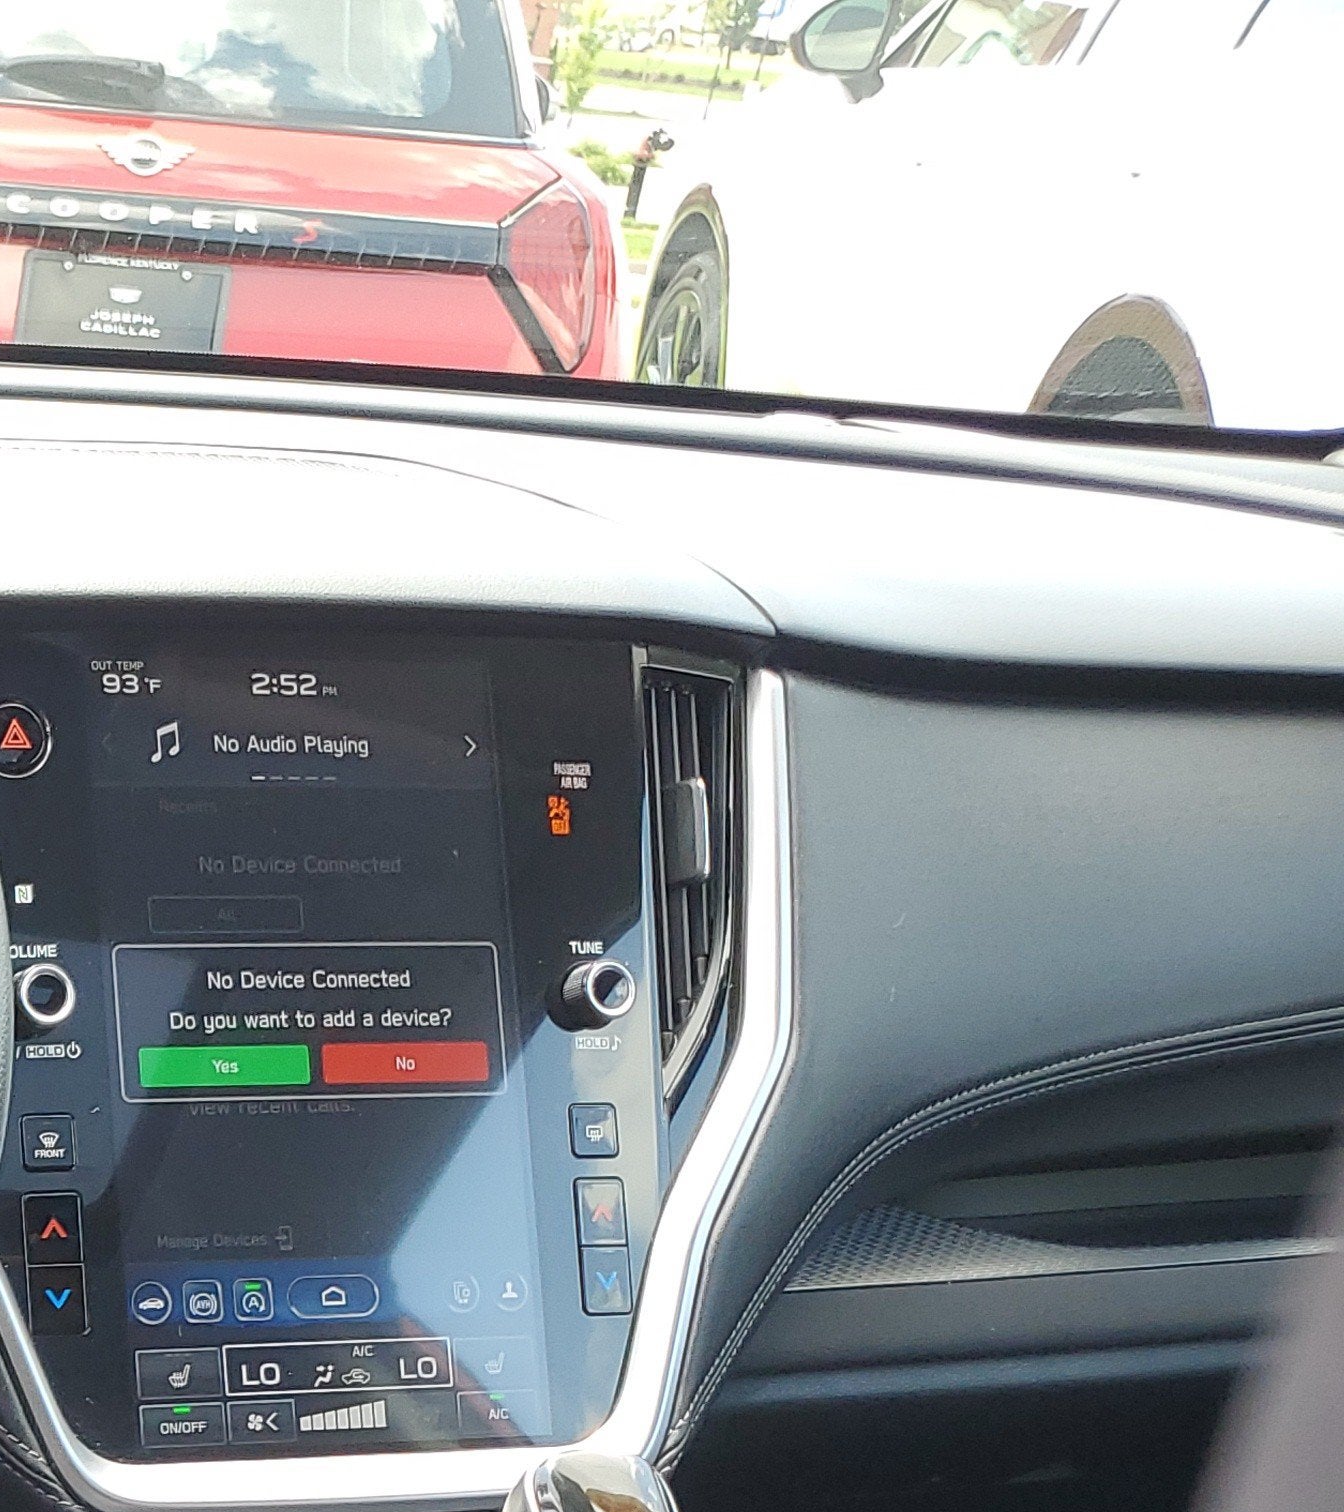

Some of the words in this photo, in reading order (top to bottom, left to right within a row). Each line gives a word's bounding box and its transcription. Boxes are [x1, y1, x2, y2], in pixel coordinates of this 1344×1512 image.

[6, 194, 259, 234] COOPER
[89, 308, 155, 326] JOSEPH
[80, 319, 161, 339] CADILLAC
[91, 660, 112, 671] OUT
[116, 660, 144, 671] TEMP
[102, 673, 139, 694] 93
[250, 673, 317, 696] 2:52
[213, 735, 239, 752] No
[247, 735, 296, 753] Audio
[304, 735, 369, 758] Playing
[199, 855, 224, 873] No
[232, 854, 296, 873] Device
[303, 854, 402, 873] Connected
[10, 944, 58, 958] OLUME
[569, 941, 604, 954] TUNE
[207, 971, 233, 989] No
[241, 971, 305, 989] Device
[312, 969, 411, 988] Connected
[170, 1012, 196, 1030] Do
[203, 1013, 237, 1034] you
[244, 1012, 289, 1029] want
[295, 1012, 315, 1029] to
[323, 1009, 355, 1028] add
[363, 1013, 374, 1028] a
[381, 1008, 452, 1028] device?
[27, 1045, 64, 1057] HOLD
[576, 1037, 609, 1049] HOLD
[212, 1060, 239, 1074] Yes
[395, 1057, 416, 1071] No
[34, 1148, 66, 1159] FRONT
[157, 1235, 208, 1250] Manage
[213, 1234, 268, 1247] Devices
[352, 1345, 374, 1359] A/C
[241, 1362, 281, 1386] LO
[399, 1356, 438, 1380] LO
[488, 1407, 510, 1421] A/C
[159, 1420, 208, 1436] ON/OFF
